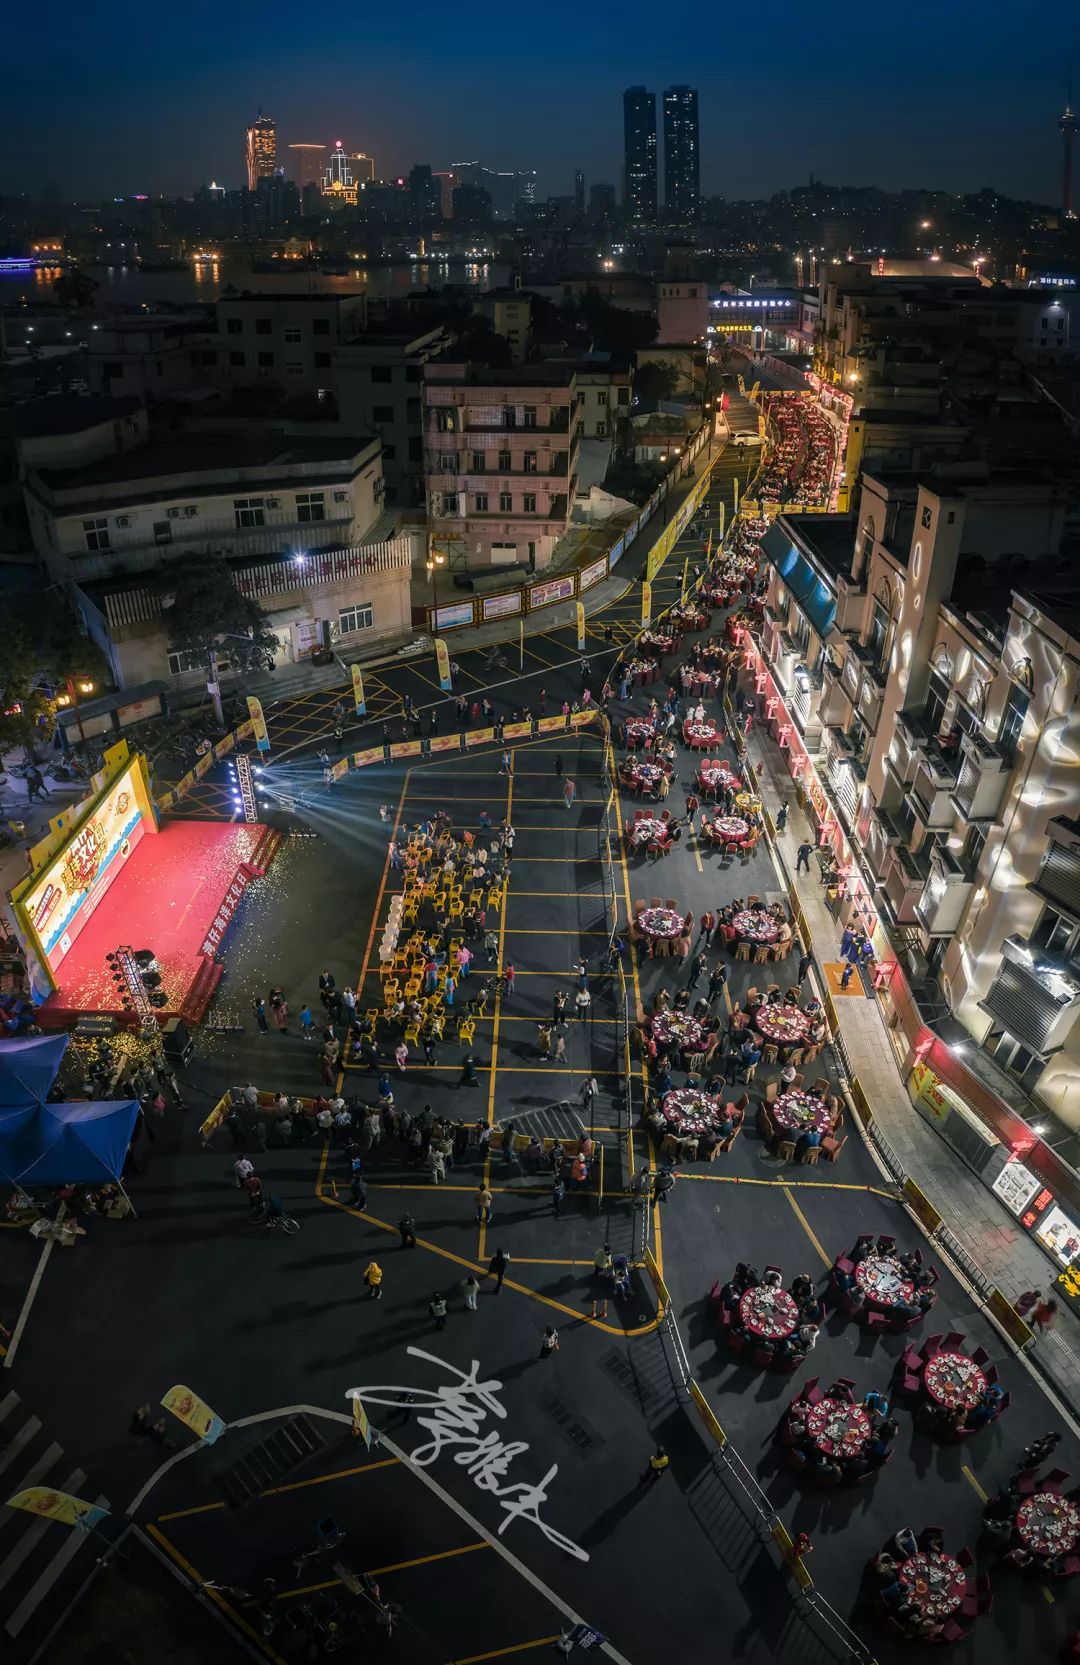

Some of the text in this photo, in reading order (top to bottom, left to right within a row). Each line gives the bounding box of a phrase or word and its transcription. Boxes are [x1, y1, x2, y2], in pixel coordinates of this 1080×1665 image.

[202, 873, 247, 957] 湾仔海洋文化日
